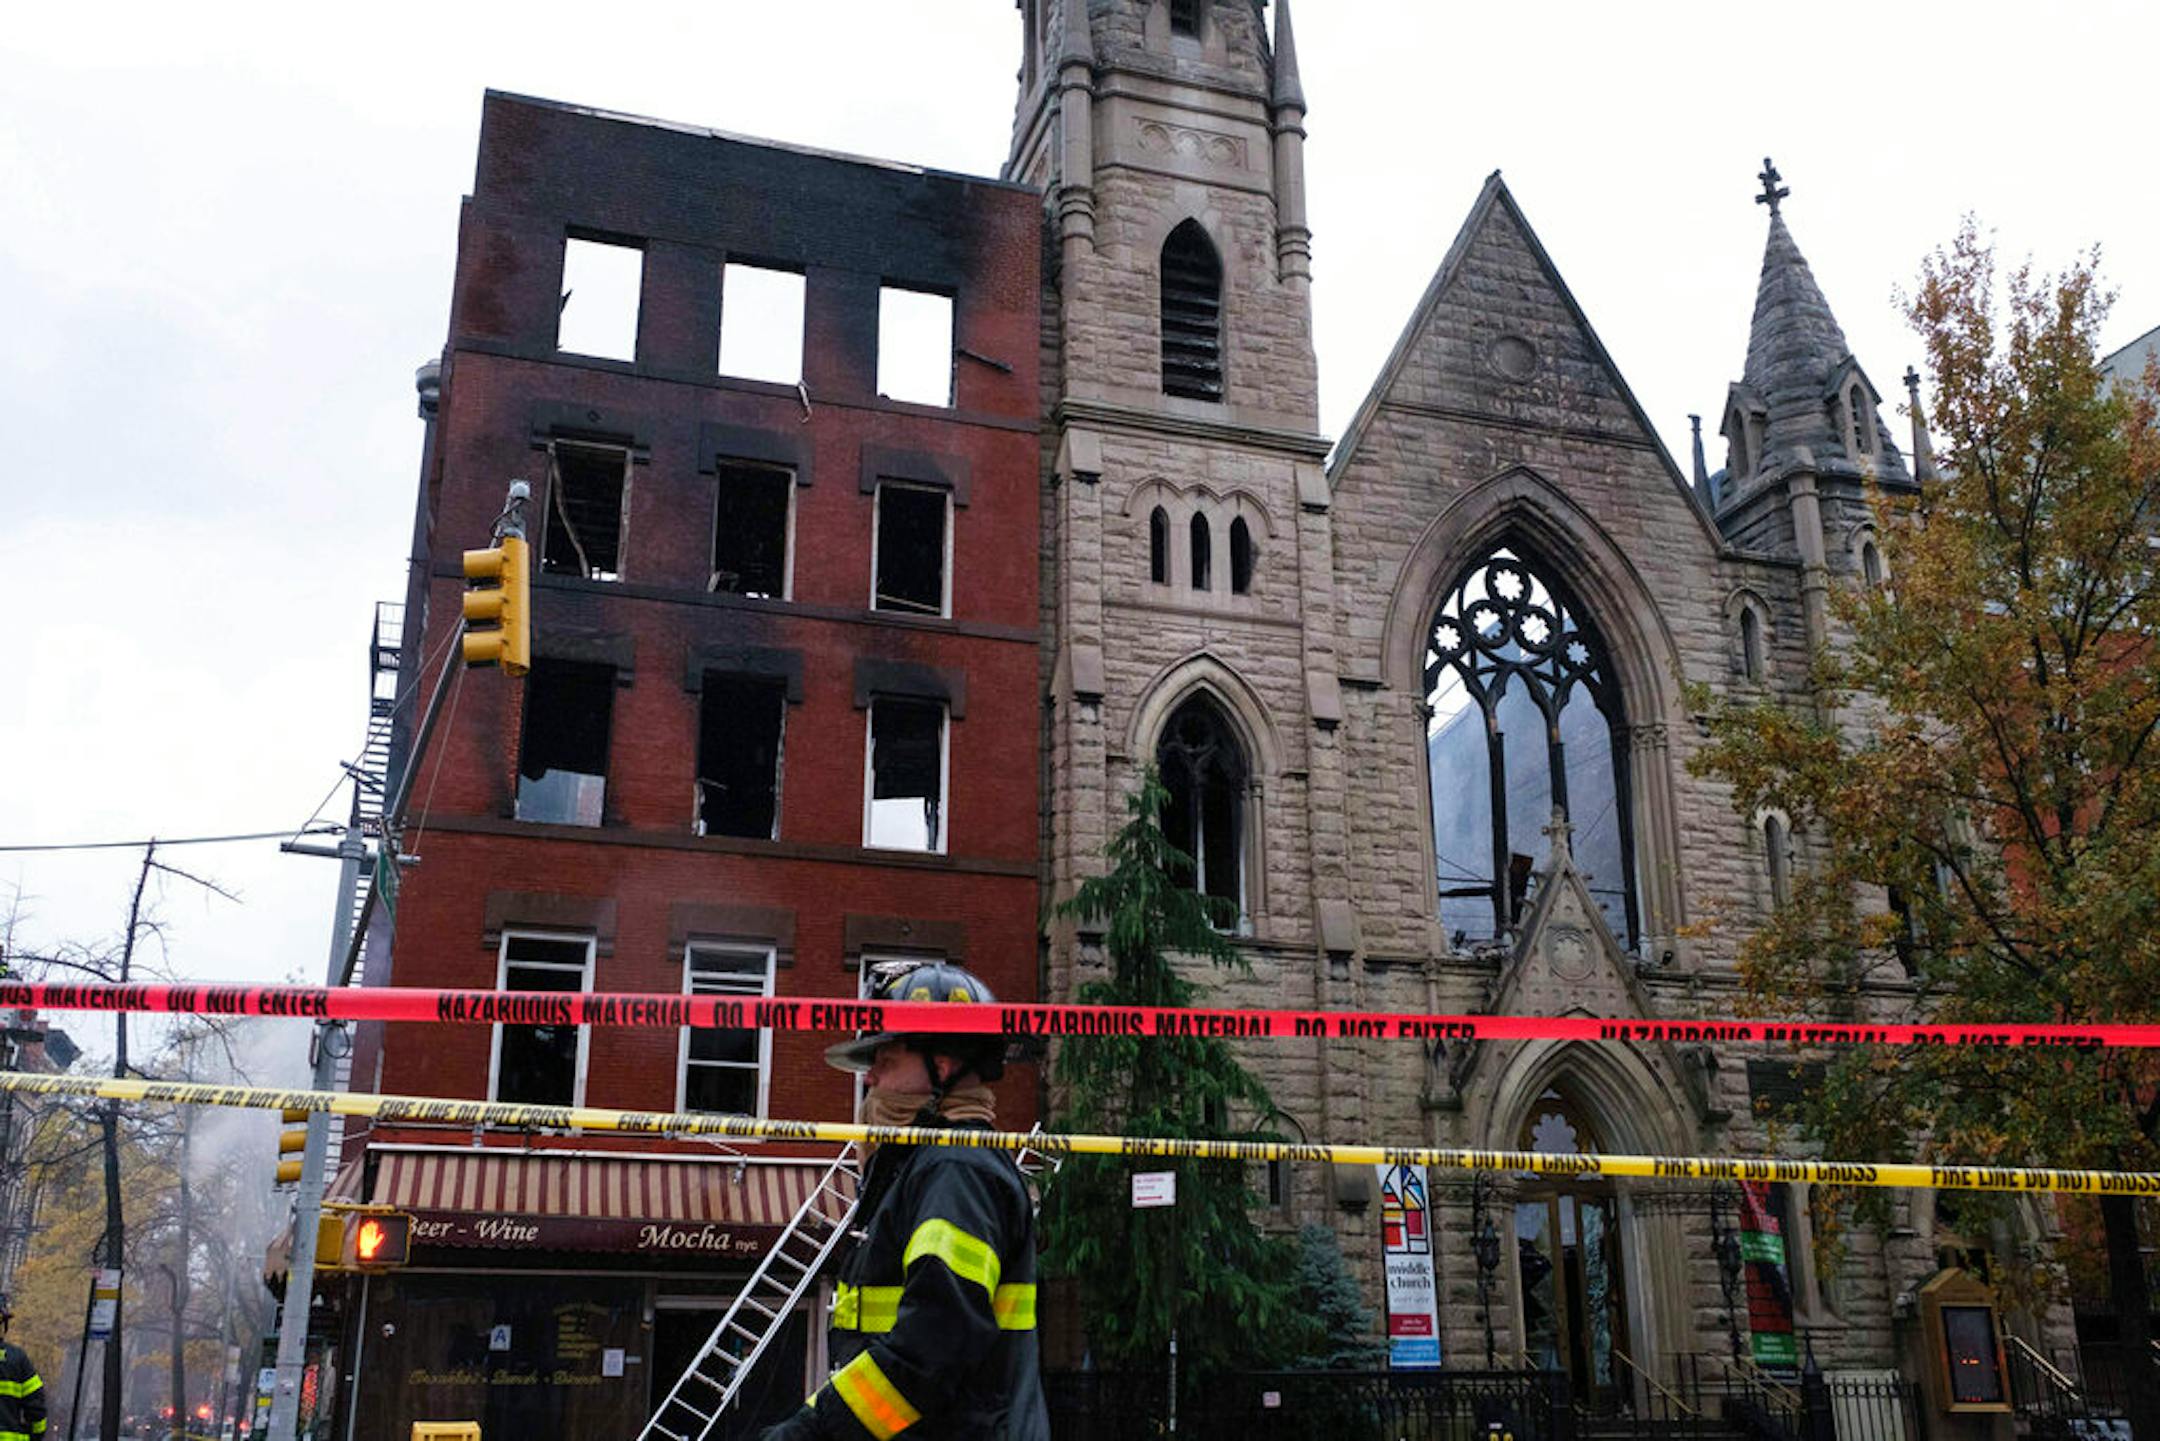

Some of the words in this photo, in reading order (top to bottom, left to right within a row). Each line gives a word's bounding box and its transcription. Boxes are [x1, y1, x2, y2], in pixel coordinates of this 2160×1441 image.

[167, 988, 195, 1012] DO
[259, 988, 328, 1016] ENTER
[438, 994, 572, 1024] HAZARDOUS
[582, 996, 691, 1026] MATERIAL
[714, 1000, 743, 1028] DO
[756, 1001, 800, 1030] NOT
[811, 1004, 884, 1032] ENTER
[1002, 1009, 1143, 1036] HAZARDOUS
[1156, 1013, 1271, 1038] MATERIAL
[1296, 1017, 1327, 1037] DO
[1340, 1019, 1387, 1039] NOT
[143, 1085, 182, 1101] FIRE
[219, 1091, 246, 1105] DO
[246, 1093, 281, 1108] NOT
[280, 1095, 336, 1112] CROSS
[377, 1100, 416, 1117] FIRE
[417, 1102, 455, 1120] LINE
[455, 1105, 481, 1121] DO
[481, 1106, 520, 1124] NOT
[518, 1107, 573, 1127] CROSS
[618, 1113, 656, 1130] FIRE
[1384, 1149, 1422, 1165] FIRE
[1429, 1150, 1467, 1167] LINE
[1472, 1152, 1496, 1169] DO
[1502, 1153, 1535, 1170] NOT
[1542, 1154, 1601, 1173] CROSS
[1654, 1157, 1693, 1176] FIRE
[1700, 1159, 1738, 1177] LINE
[1745, 1160, 1769, 1179] DO
[1776, 1162, 1809, 1180] NOT
[1816, 1163, 1877, 1182] CROSS
[1932, 1166, 1972, 1184] FIRE
[1978, 1168, 2018, 1187] LINE
[2025, 1170, 2050, 1188] DO
[2057, 1171, 2091, 1190] NOT
[474, 1217, 539, 1241] Wine
[638, 1224, 731, 1250] Mocha
[735, 1239, 758, 1253] nyc
[1390, 1276, 1431, 1289] church
[495, 1329, 507, 1343] A
